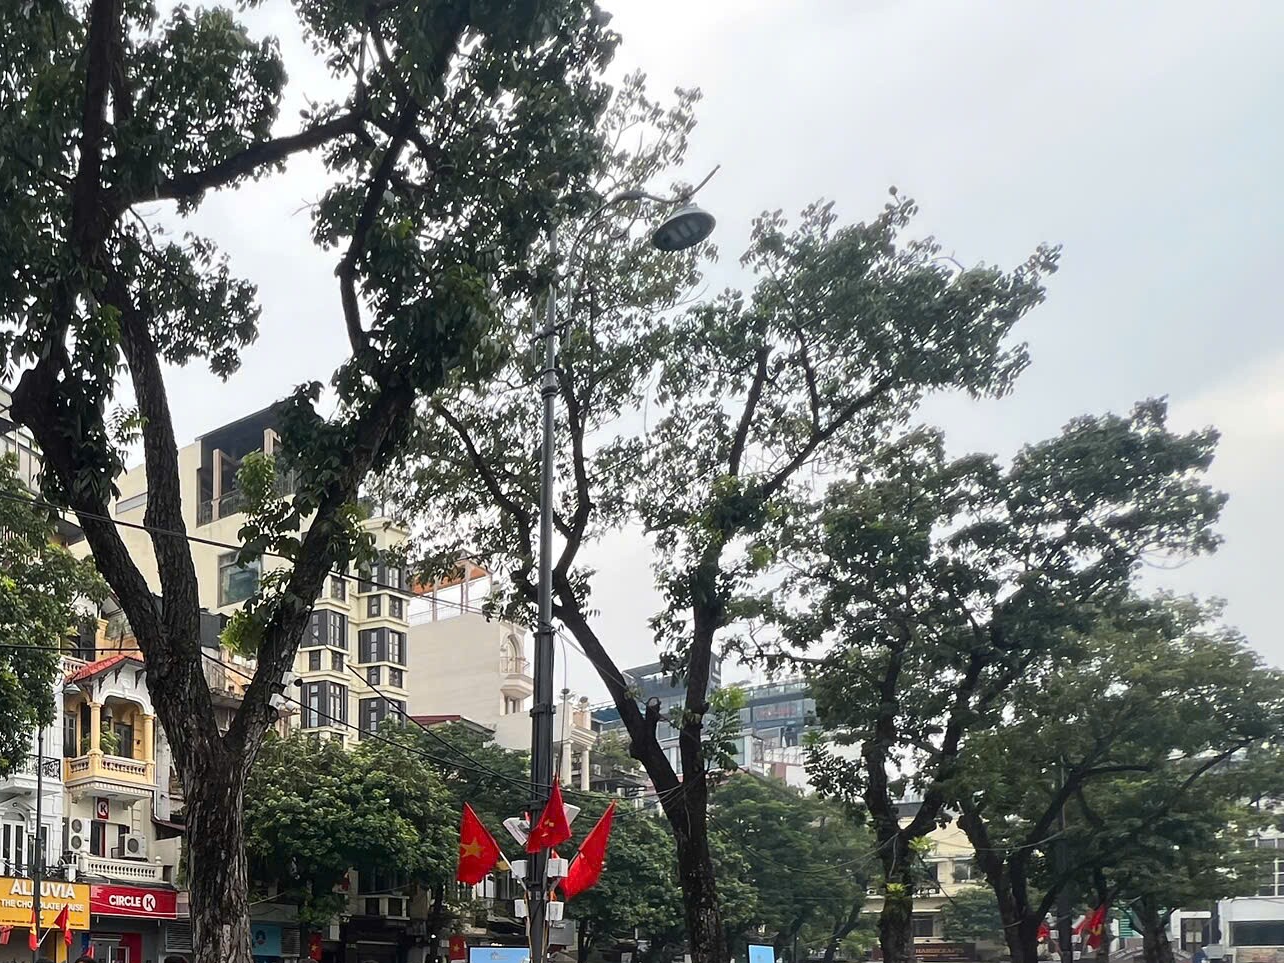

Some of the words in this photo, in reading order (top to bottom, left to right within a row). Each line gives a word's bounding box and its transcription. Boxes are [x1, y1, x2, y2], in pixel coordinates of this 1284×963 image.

[1, 899, 15, 907] THE
[17, 900, 61, 911] CHOOLATE
[109, 895, 141, 907] CIRCLE
